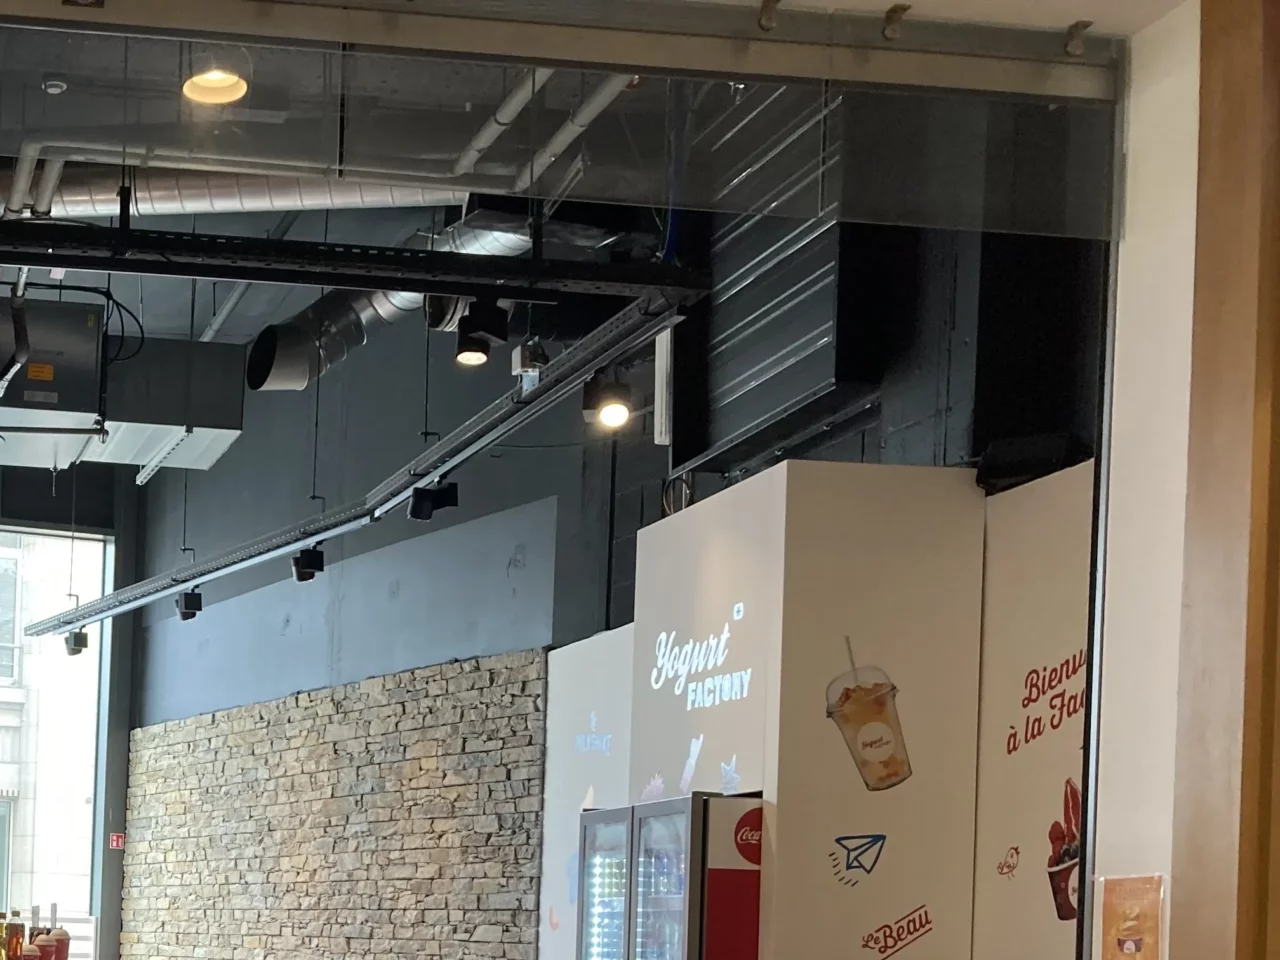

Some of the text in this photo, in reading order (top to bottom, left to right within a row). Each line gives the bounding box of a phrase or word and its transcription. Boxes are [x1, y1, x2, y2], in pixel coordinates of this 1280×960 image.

[651, 621, 730, 695] Yogurt
[1022, 648, 1087, 709] Bienv
[686, 667, 751, 711] FACTORY
[1007, 725, 1021, 755] à
[1024, 715, 1046, 744] la
[861, 910, 932, 955] Le Beau
